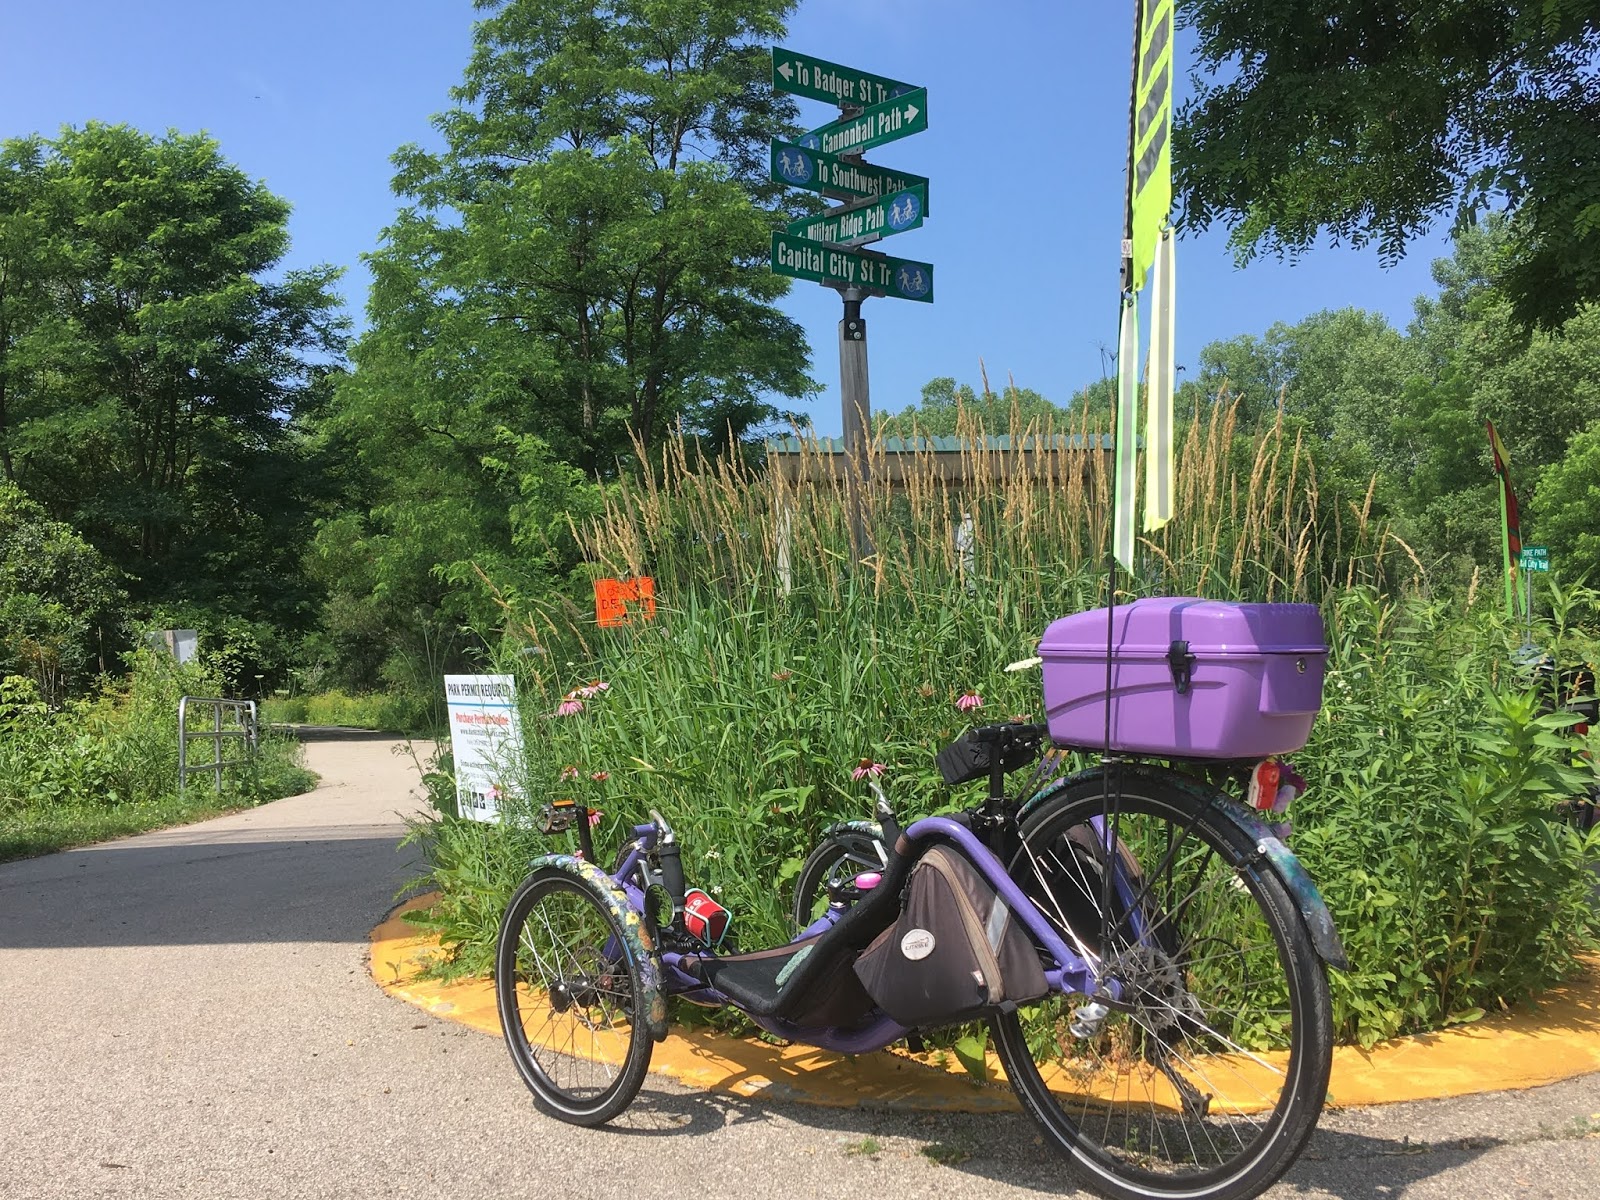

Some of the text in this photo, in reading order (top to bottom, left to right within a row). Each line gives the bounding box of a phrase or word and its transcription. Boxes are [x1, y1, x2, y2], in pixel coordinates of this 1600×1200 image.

[795, 60, 888, 103] To Badger St Tr
[822, 107, 902, 153] Cannonball Path
[817, 159, 828, 183] To
[832, 163, 882, 196] Southwest
[807, 205, 885, 243] Military Ridge Path
[778, 241, 892, 286] Capital City St Tr
[1534, 548, 1547, 557] PATH
[447, 683, 461, 696] PARK
